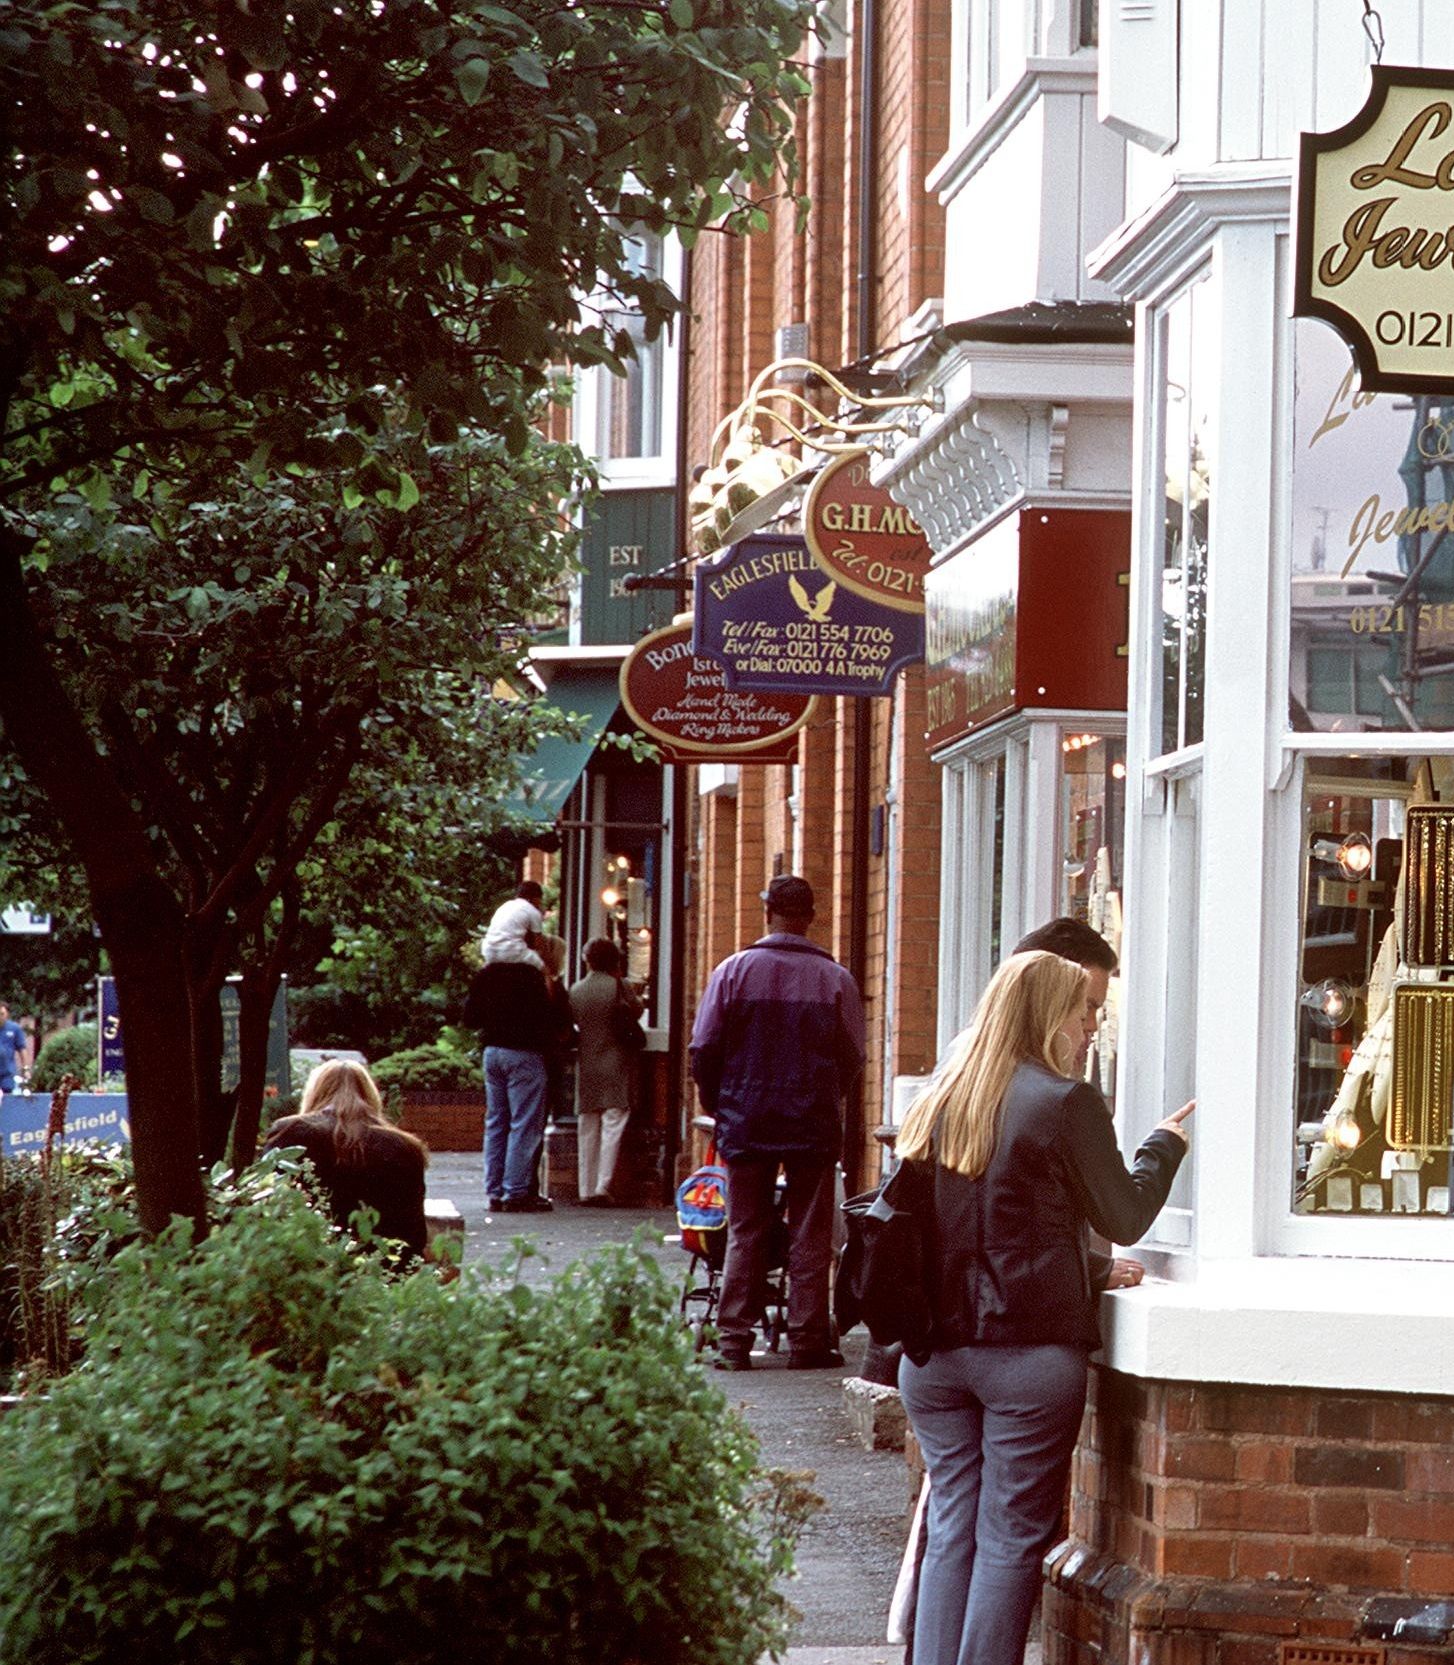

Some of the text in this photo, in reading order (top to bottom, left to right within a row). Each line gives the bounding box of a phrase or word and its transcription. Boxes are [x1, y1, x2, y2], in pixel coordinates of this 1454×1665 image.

[609, 545, 643, 565] EST
[1350, 604, 1406, 633] 0121
[785, 622, 816, 640] 0121
[820, 624, 850, 641] 554
[854, 625, 895, 643] 7706
[787, 641, 817, 658] 0121
[821, 642, 847, 659] 776
[851, 644, 892, 661] 7969
[735, 661, 749, 672] or
[776, 659, 822, 674] 07000
[847, 661, 886, 682] Trophy
[676, 692, 758, 709] Hand Made
[652, 706, 791, 726] Diamond & Wedding
[680, 722, 717, 740] Ring
[10, 1110, 117, 1146] Eagsfield
